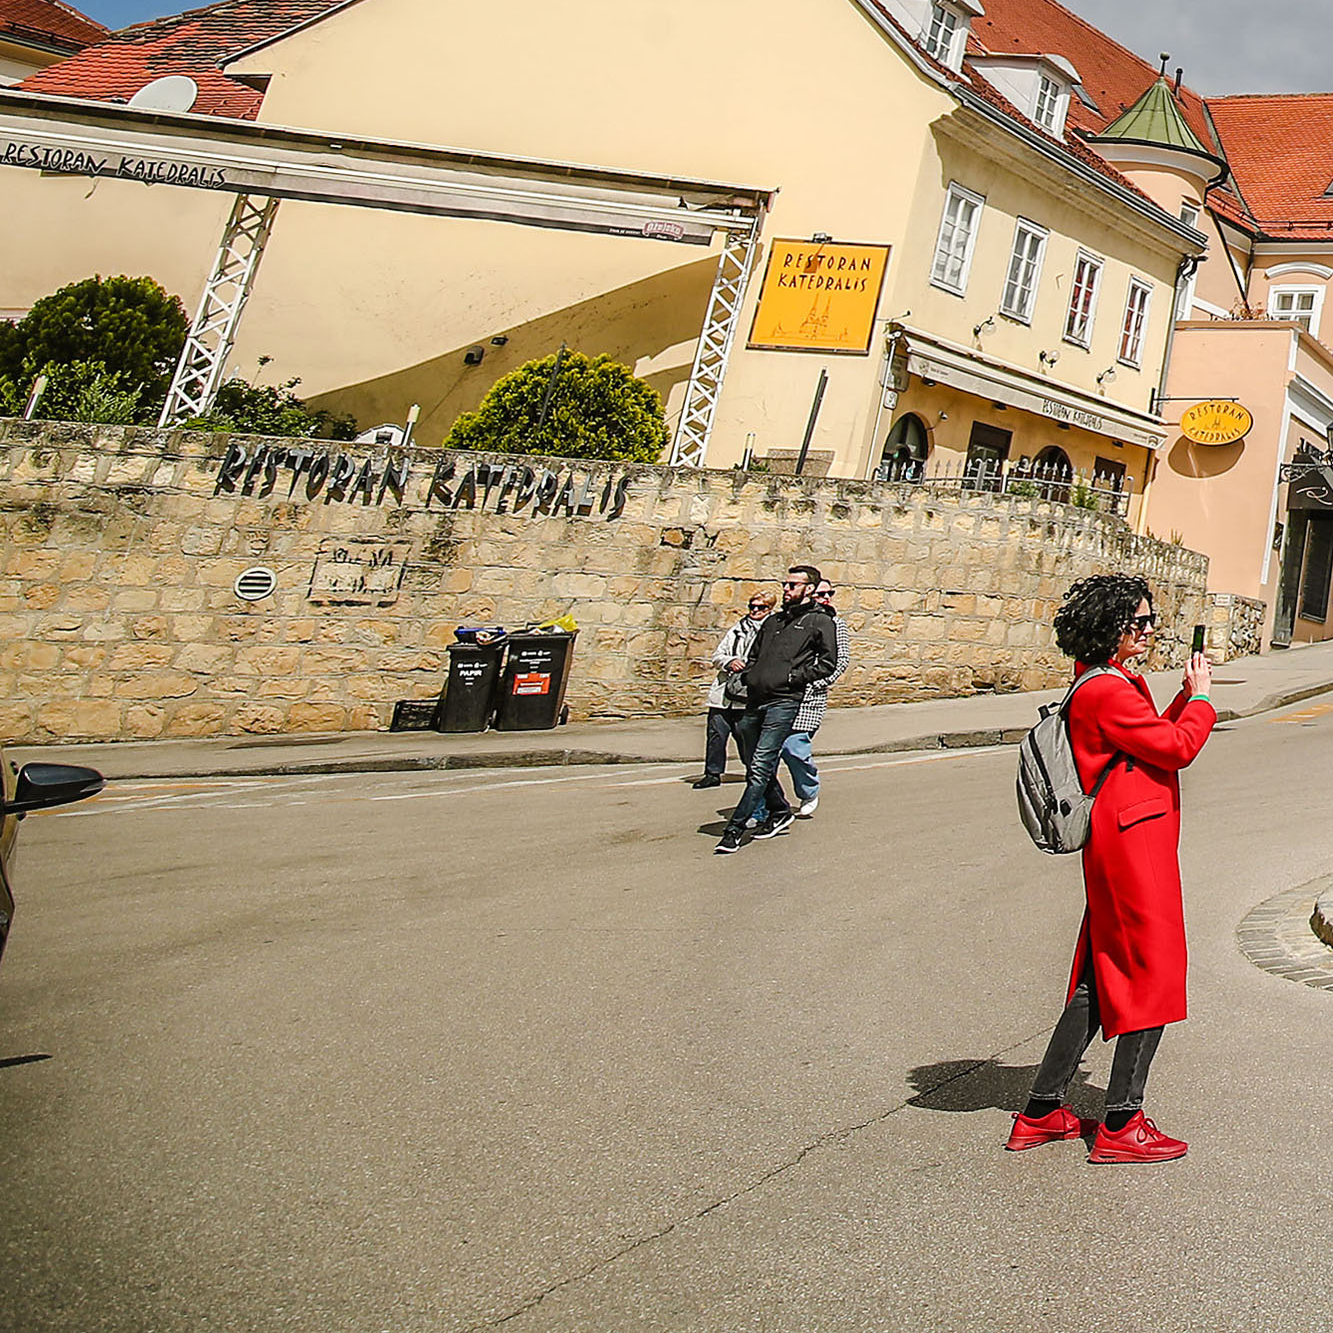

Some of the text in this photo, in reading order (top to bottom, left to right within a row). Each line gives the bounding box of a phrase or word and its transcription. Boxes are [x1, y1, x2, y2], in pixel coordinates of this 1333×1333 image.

[3, 142, 106, 174] RESTORAN
[783, 253, 871, 271] RESTORAN
[1189, 404, 1244, 420] RESTORAN
[213, 444, 410, 507] RESTORAN
